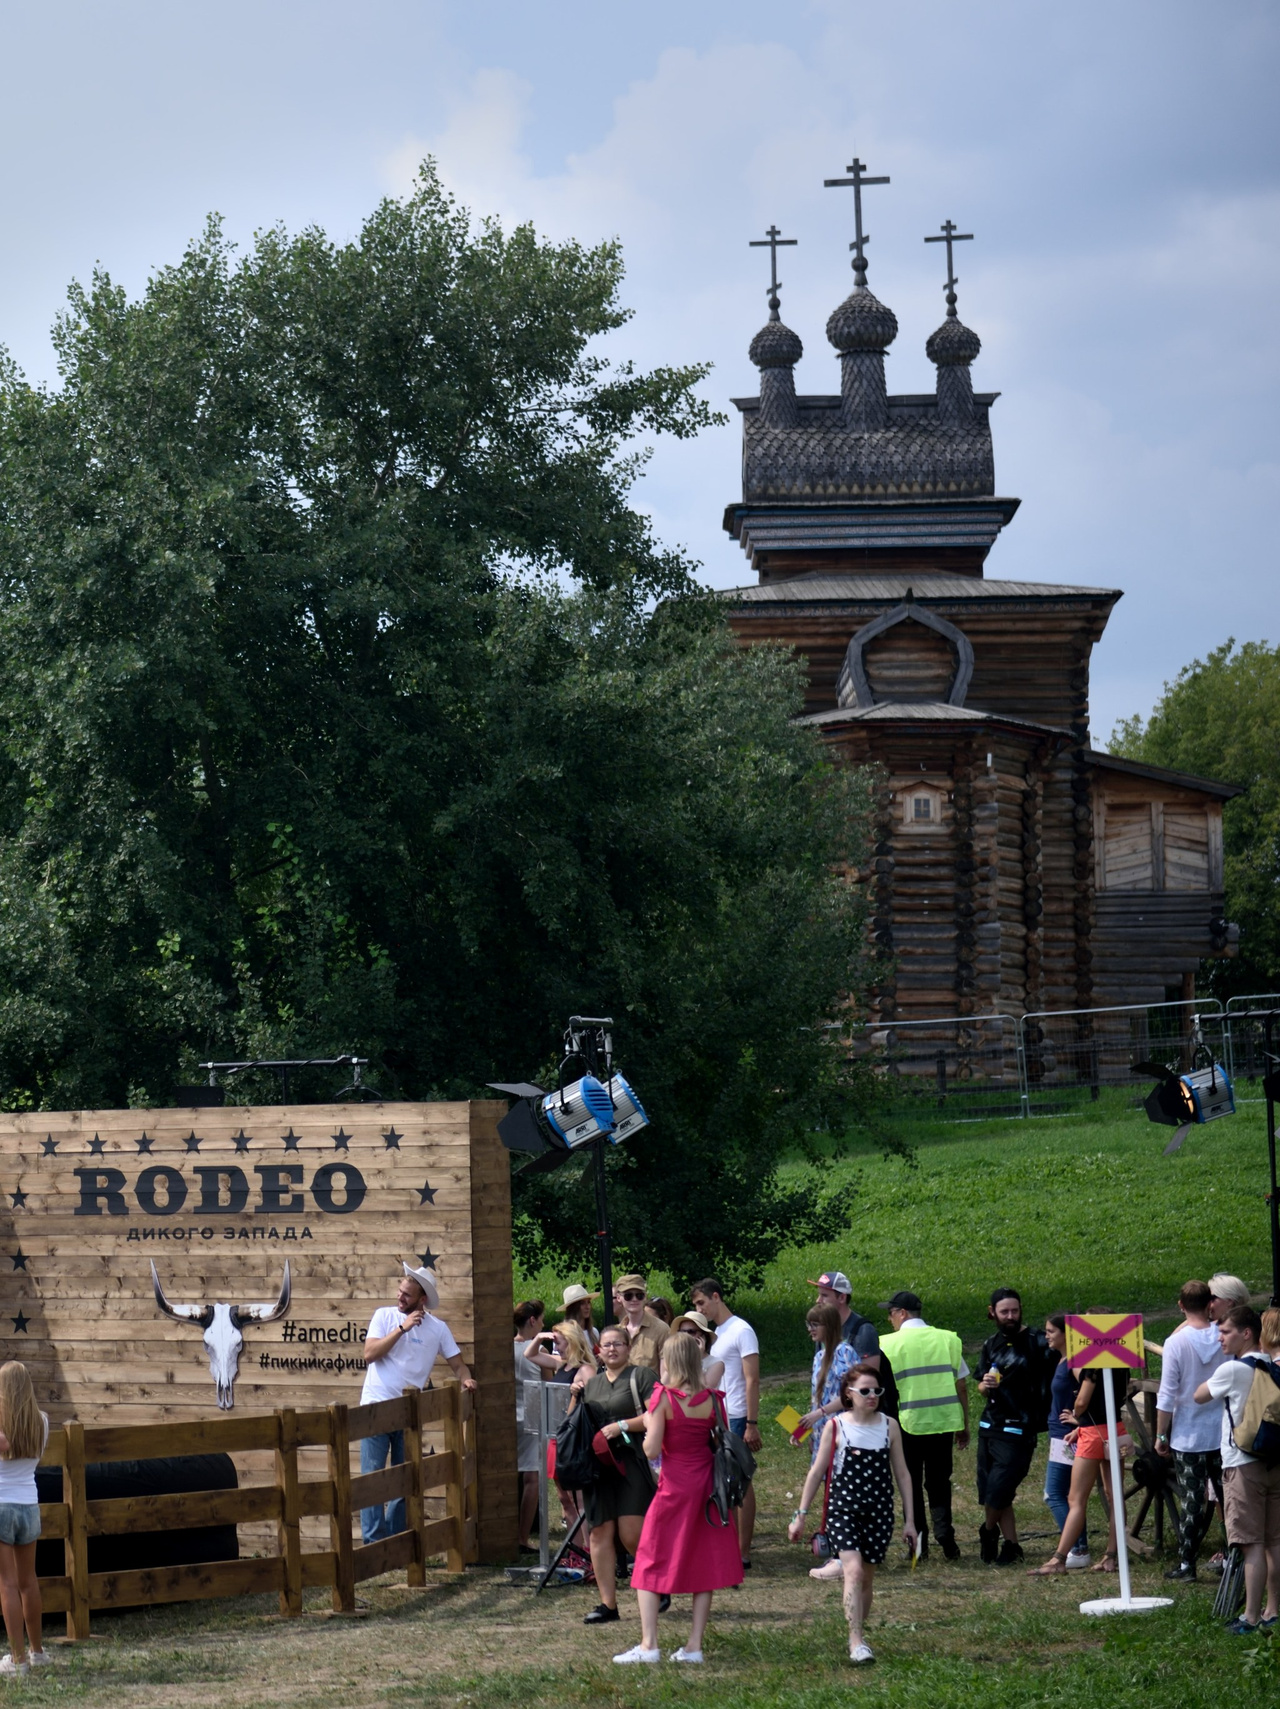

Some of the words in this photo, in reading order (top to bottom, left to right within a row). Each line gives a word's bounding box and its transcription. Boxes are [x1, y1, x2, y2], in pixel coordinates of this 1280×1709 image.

[74, 1163, 367, 1215] RODEO
[127, 1227, 214, 1242] ДИКОГО
[223, 1225, 313, 1241] ЗАПАДА
[1079, 1338, 1091, 1346] НЕ
[1093, 1337, 1127, 1347] КУРИТЬ
